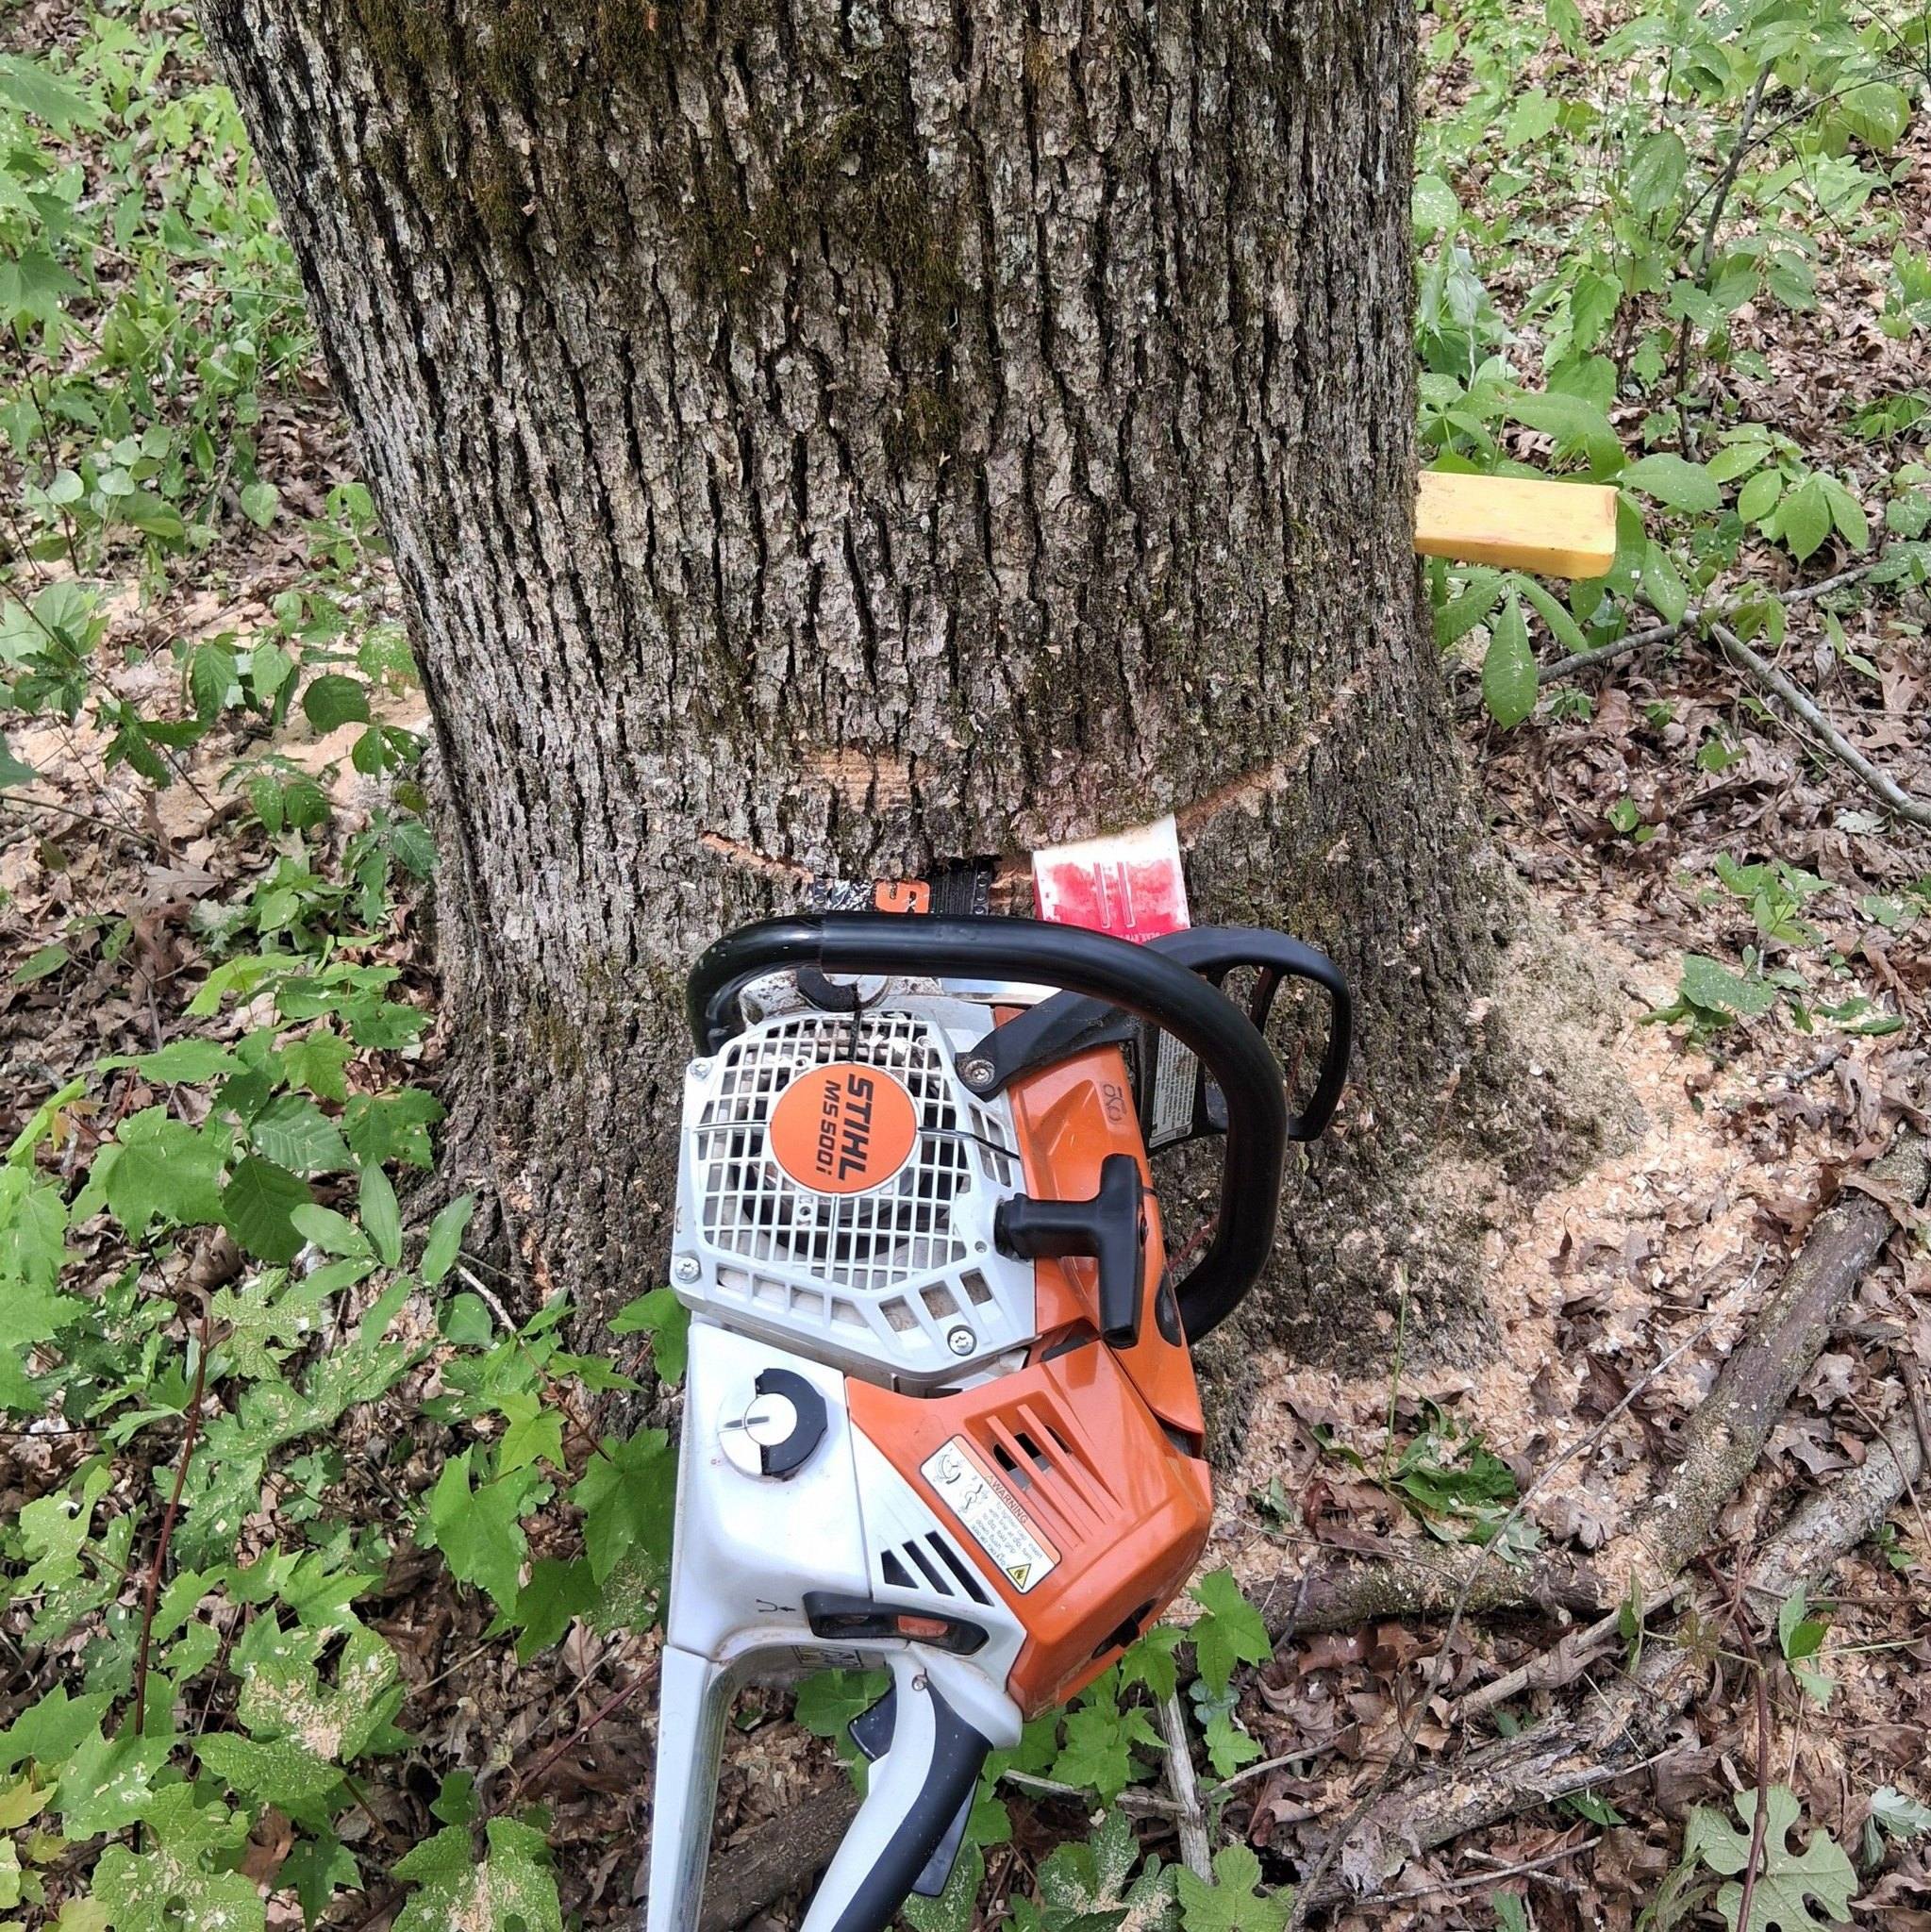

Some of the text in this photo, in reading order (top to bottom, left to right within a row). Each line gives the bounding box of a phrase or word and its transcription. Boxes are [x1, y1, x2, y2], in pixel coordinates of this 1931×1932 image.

[816, 1079, 841, 1175] MS 500i
[839, 1074, 874, 1181] STIHL
[990, 1480, 1028, 1524] WARNING
